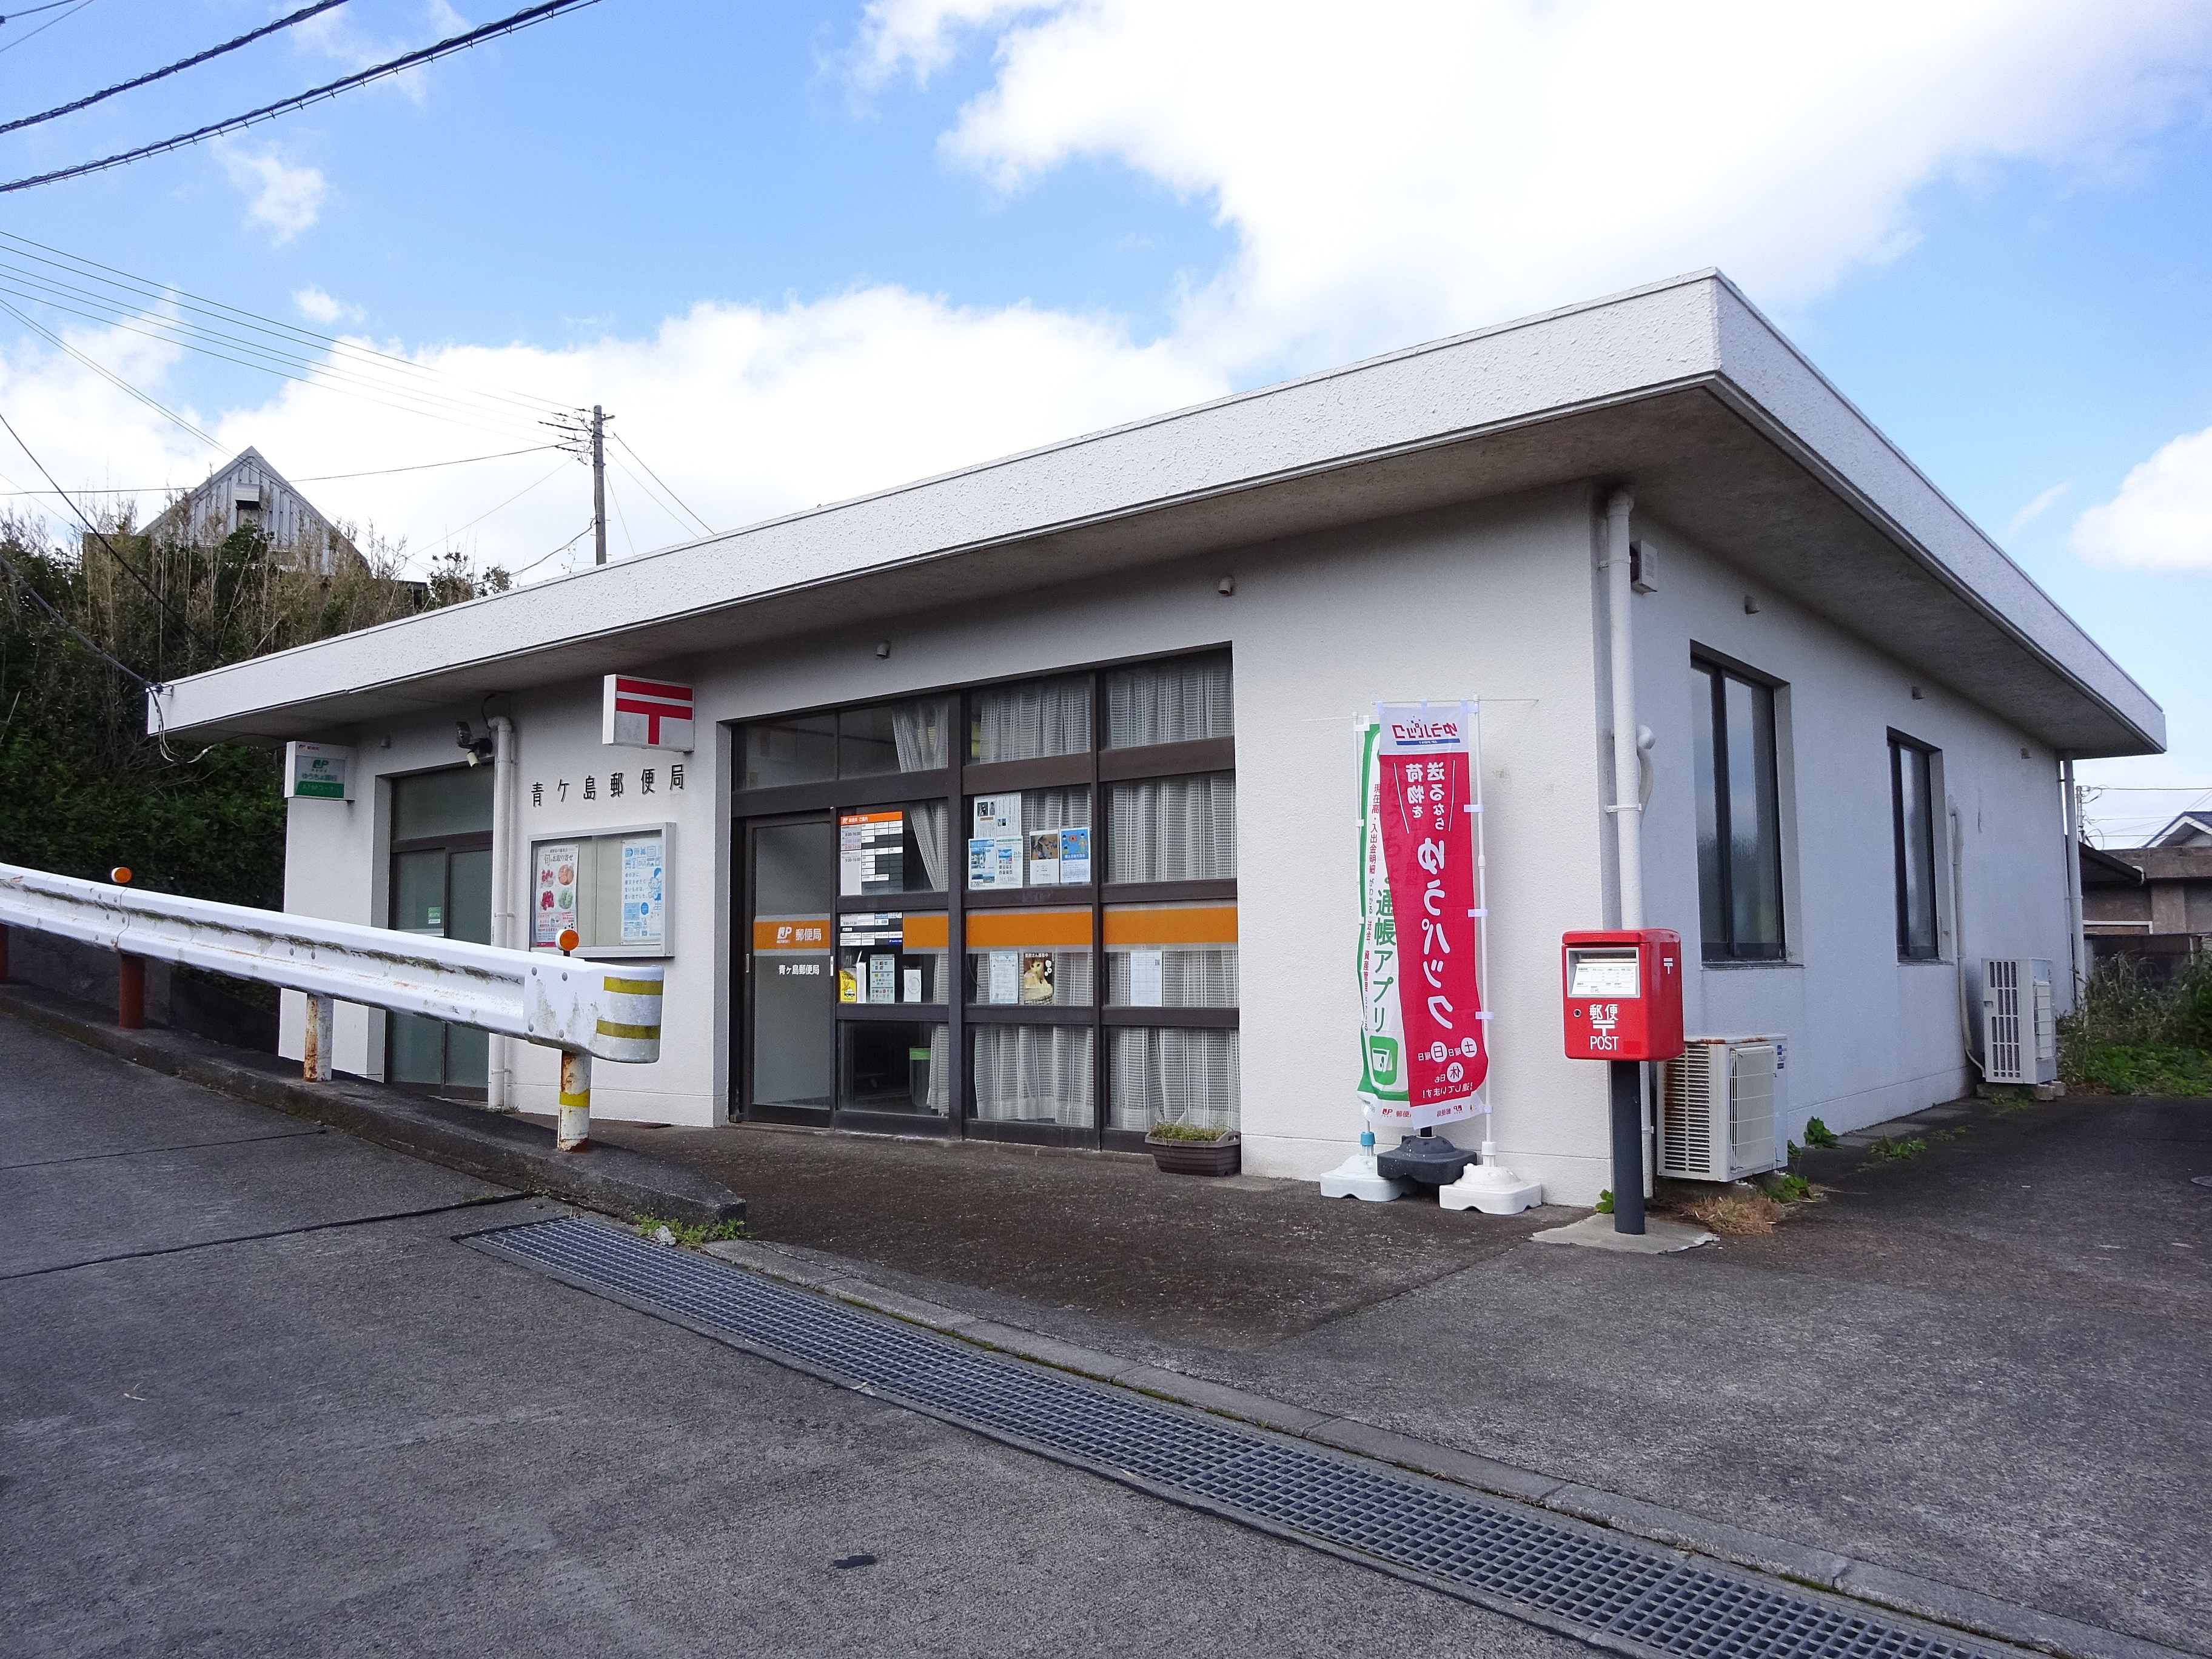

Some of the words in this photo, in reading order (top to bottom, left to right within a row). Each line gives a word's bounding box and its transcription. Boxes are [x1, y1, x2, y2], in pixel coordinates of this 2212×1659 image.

[795, 928, 822, 941] 郵便局
[1373, 889, 1396, 1033] 通帳アプリ
[1589, 1004, 1619, 1021] 郵便
[1590, 1036, 1620, 1050] POST
